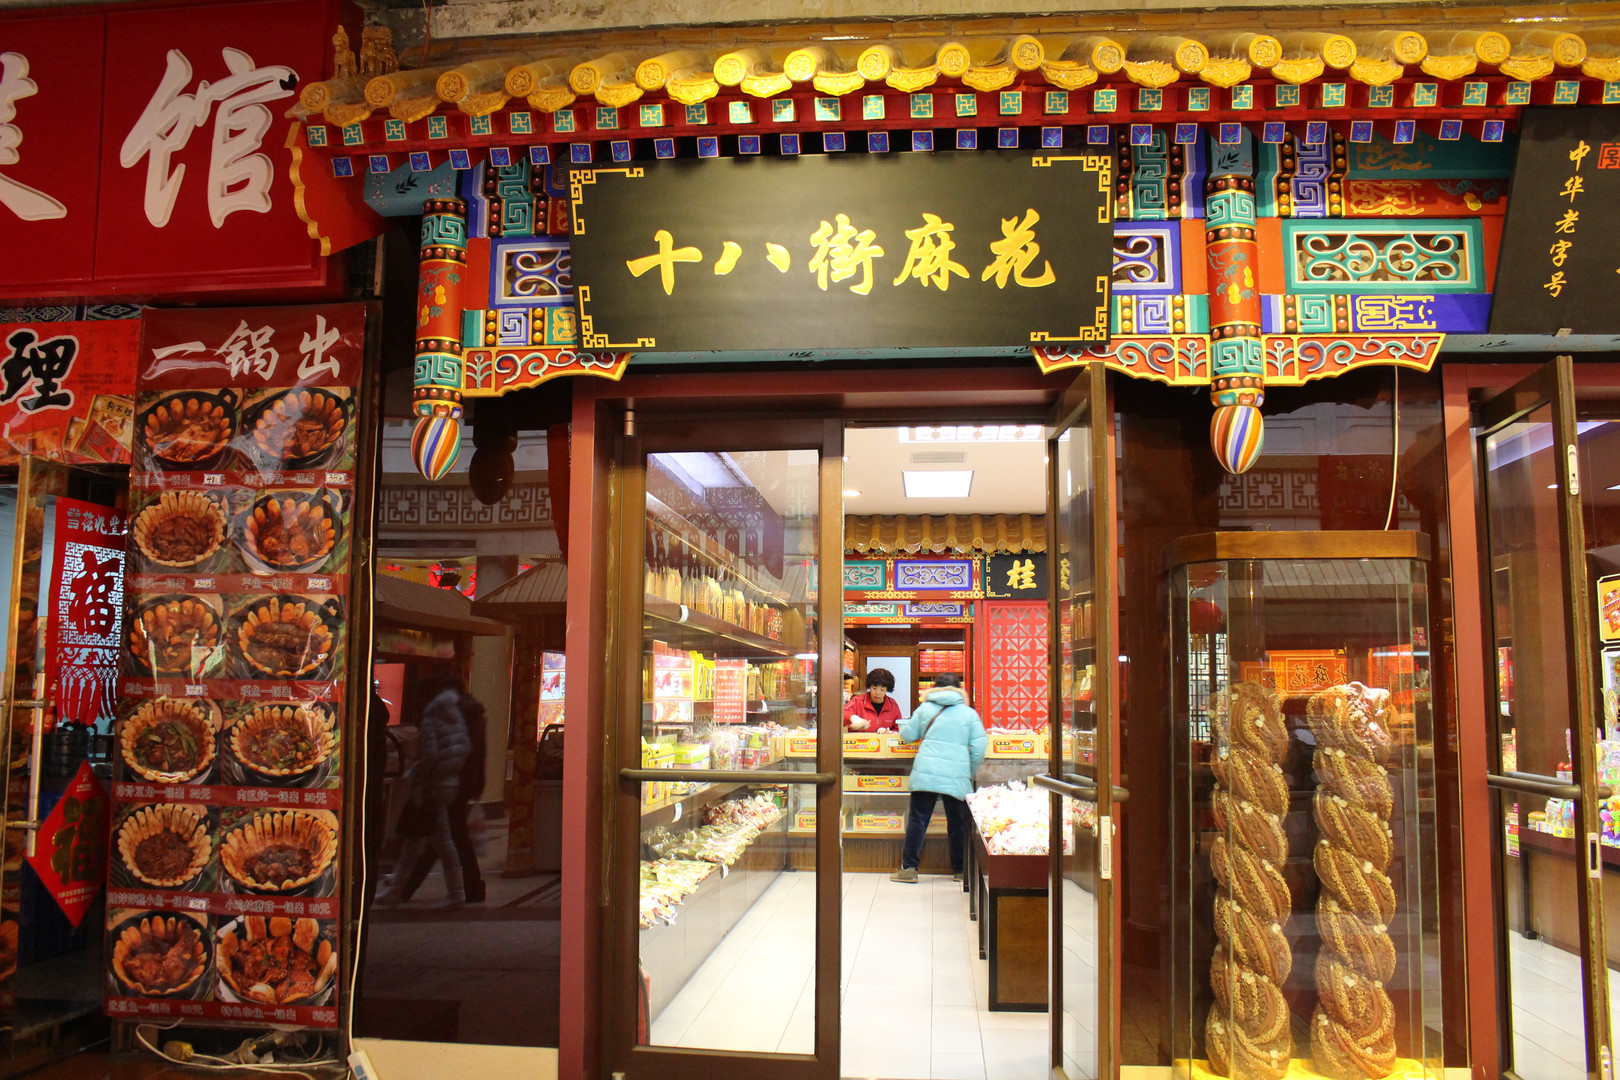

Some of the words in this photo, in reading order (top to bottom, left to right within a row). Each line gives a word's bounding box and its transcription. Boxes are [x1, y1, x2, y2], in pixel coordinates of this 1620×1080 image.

[626, 208, 1056, 296] 十八街麻花
[1543, 140, 1591, 298] 中华老字号
[0, 329, 78, 413] 理
[152, 314, 341, 382] 一锅出
[1006, 558, 1037, 590] 桂
